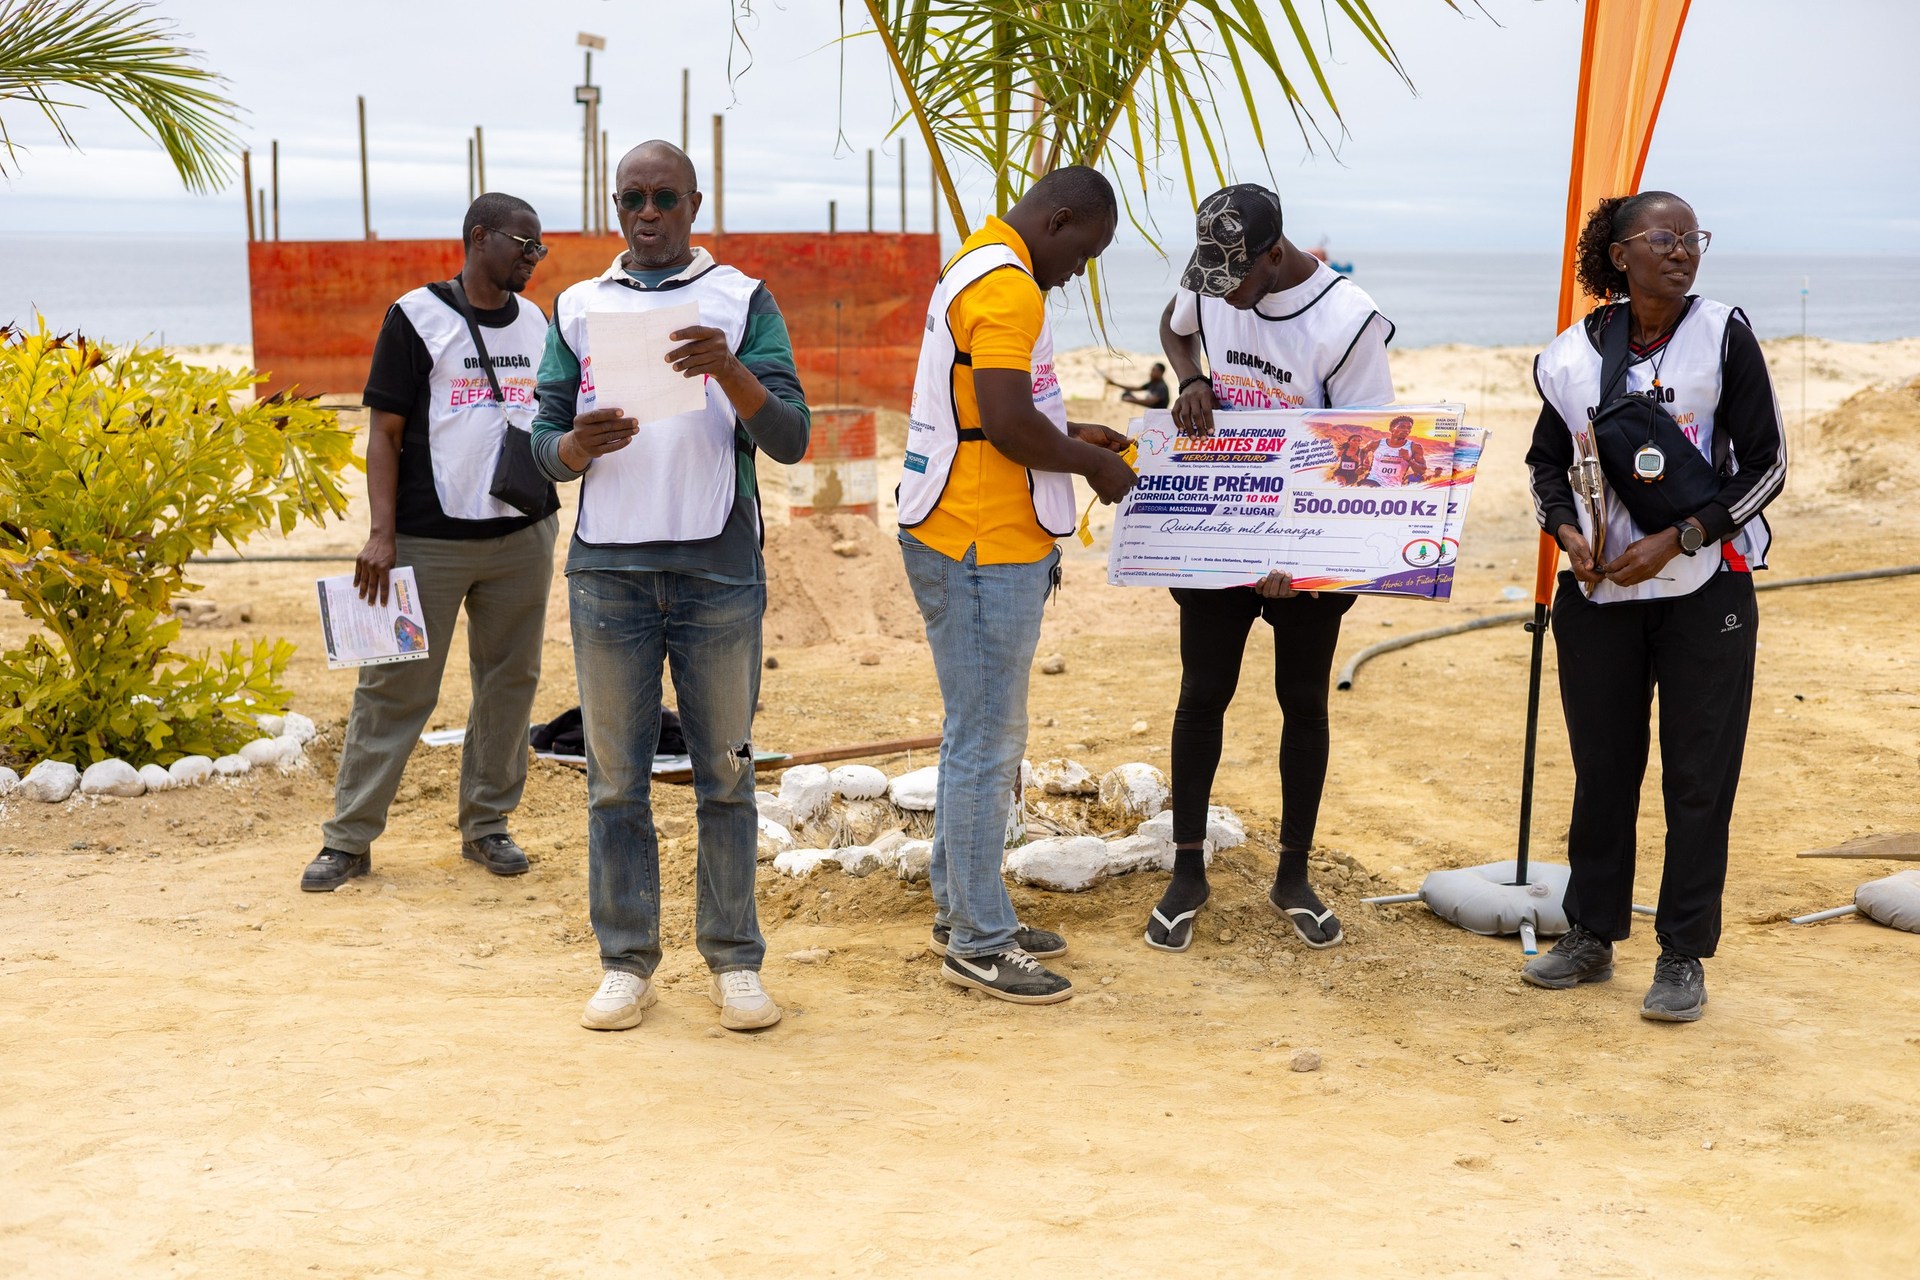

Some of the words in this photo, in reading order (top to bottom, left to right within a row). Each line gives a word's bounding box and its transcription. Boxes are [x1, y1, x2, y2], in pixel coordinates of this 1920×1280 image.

[451, 386, 525, 406] ELEFATES
[1218, 428, 1286, 438] PAN-AFRICANO
[1682, 424, 1698, 445] AY
[1173, 437, 1254, 452] ELEFANTES
[1255, 438, 1287, 452] BAY
[1290, 440, 1310, 450] Mais
[1310, 438, 1319, 446] do
[1182, 453, 1214, 462] HERÓIS
[1216, 454, 1230, 462] DO
[1232, 454, 1267, 462] FUTURO
[1305, 450, 1334, 462] geração
[1136, 475, 1209, 493] CHEQUE
[1213, 473, 1284, 492] PRÉMIO
[1134, 492, 1175, 502] CORRIDA
[1177, 494, 1242, 502] CORTA-MATO
[1245, 494, 1258, 502] 10
[1260, 495, 1280, 503] KM
[1240, 506, 1275, 516] LUGAR
[1293, 498, 1408, 518] 500.000,00
[1410, 500, 1438, 516] Kz
[1160, 518, 1235, 534] Quinhentos
[1238, 520, 1262, 534] mil
[1265, 522, 1324, 540] kwanzas
[1416, 574, 1436, 586] Futur
